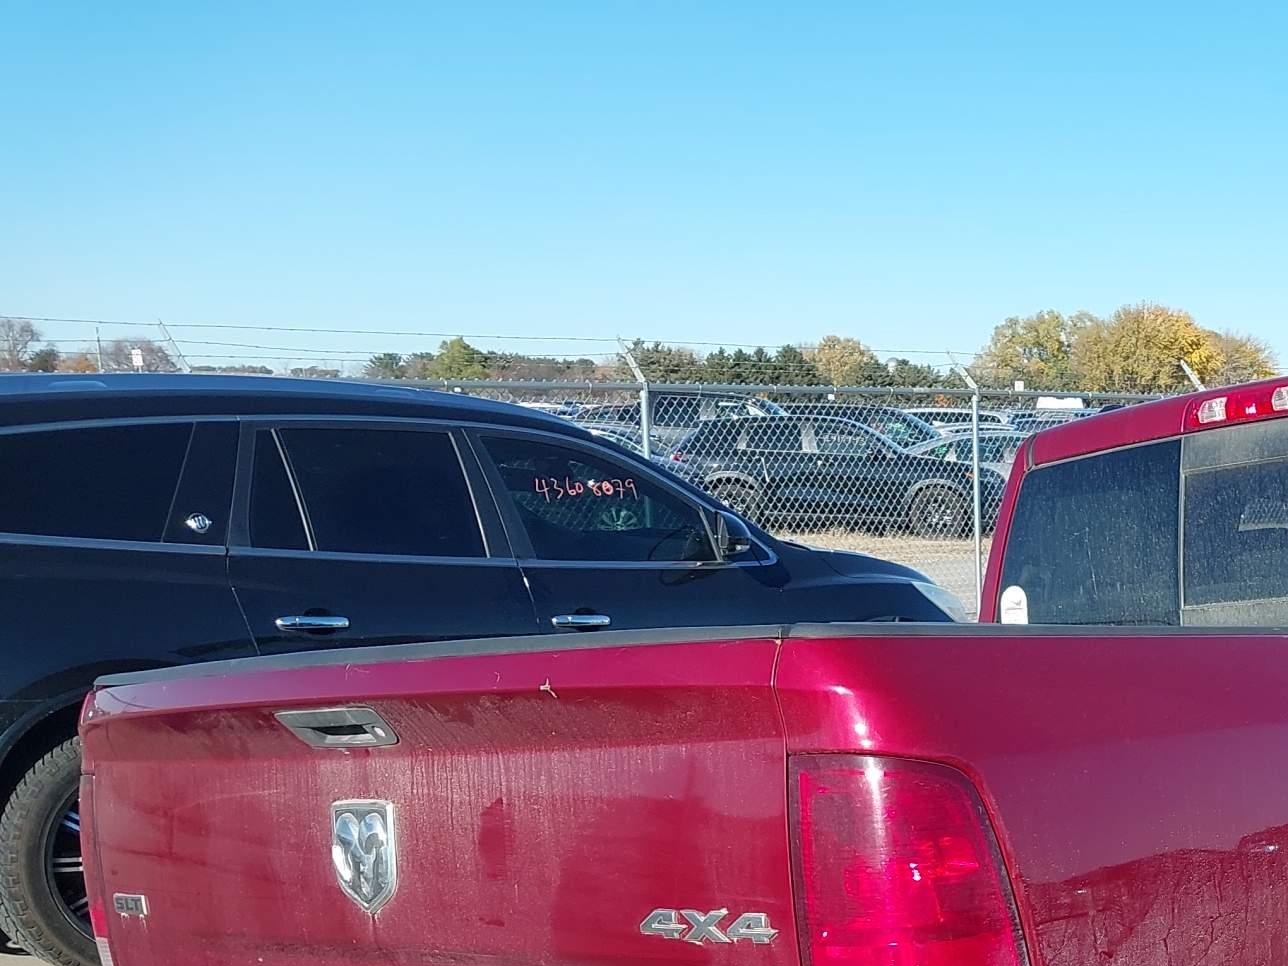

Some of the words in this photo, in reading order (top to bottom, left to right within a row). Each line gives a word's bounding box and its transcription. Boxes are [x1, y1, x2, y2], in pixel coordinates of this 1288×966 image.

[535, 476, 639, 503] 43608079
[115, 896, 142, 912] SLT
[639, 907, 780, 944] 4X4
